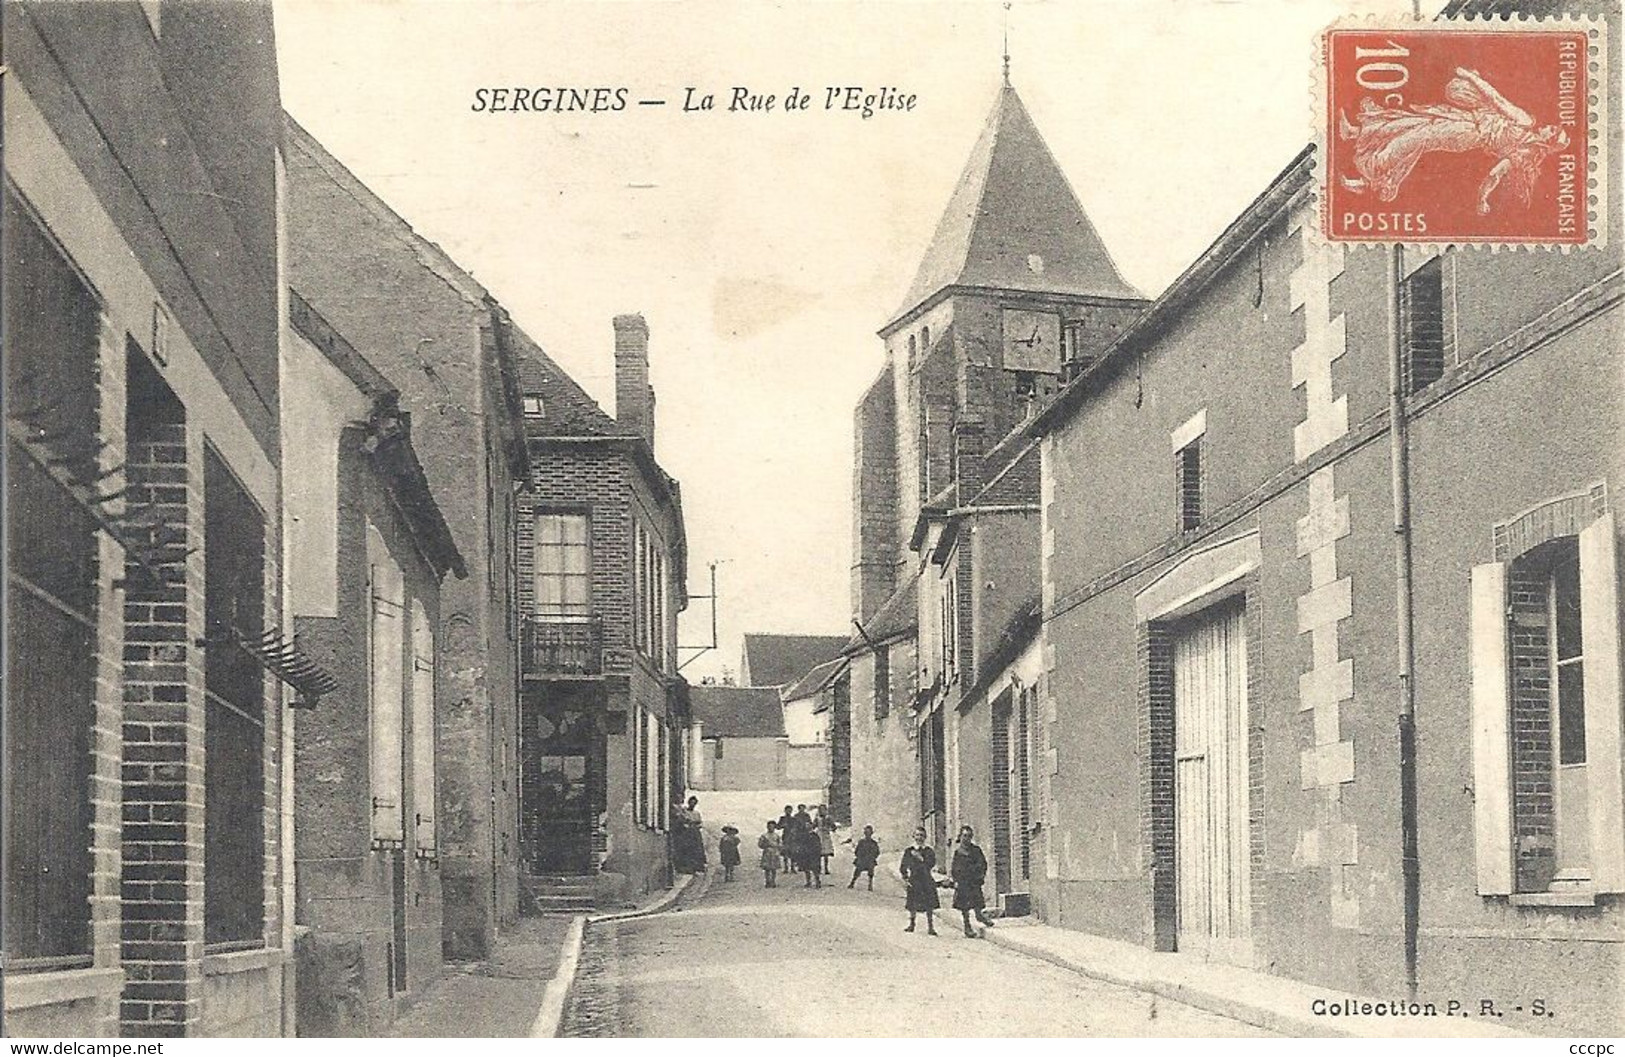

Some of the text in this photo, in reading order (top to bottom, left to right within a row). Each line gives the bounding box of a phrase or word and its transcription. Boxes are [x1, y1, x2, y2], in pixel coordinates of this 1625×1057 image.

[1557, 41, 1577, 235] REPUBLIQUE FRANÇAISE
[1343, 212, 1427, 232] POSTES
